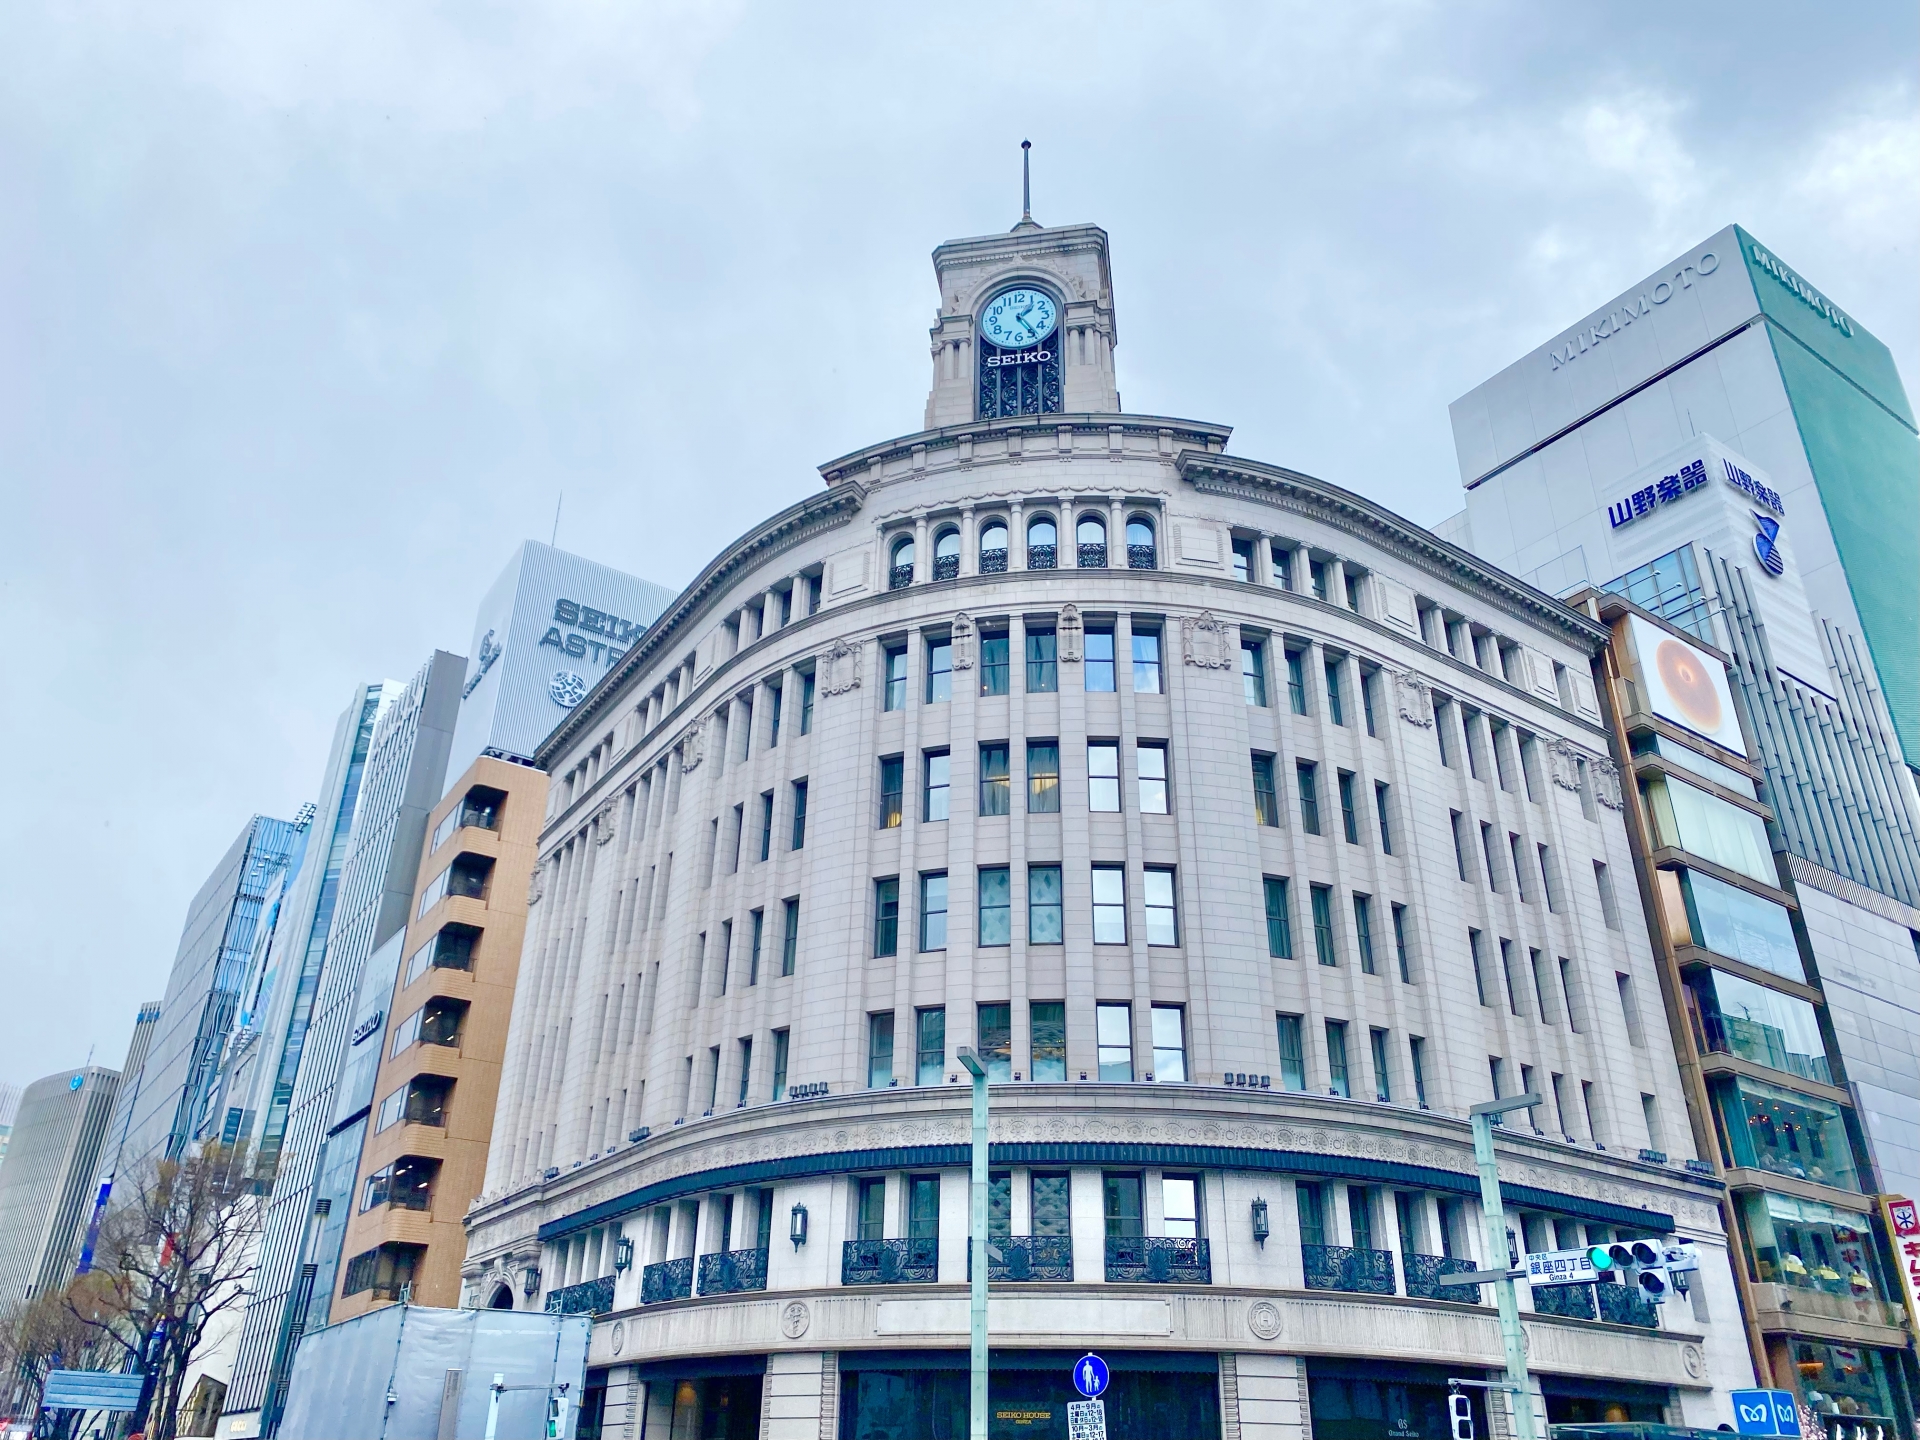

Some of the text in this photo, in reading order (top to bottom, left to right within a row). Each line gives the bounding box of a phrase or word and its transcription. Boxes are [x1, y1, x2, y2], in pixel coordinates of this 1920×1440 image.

[1752, 245, 1855, 338] MIKIMOTO
[1003, 297, 1012, 307] 11
[1014, 293, 1025, 303] 12
[993, 306, 1003, 315] 10
[1037, 301, 1046, 310] 2
[1041, 310, 1050, 320] 3
[1550, 252, 1721, 371] MIKIMOTO
[988, 316, 998, 326] 9
[1036, 321, 1046, 330] 4
[993, 325, 1002, 335] 8
[1027, 328, 1036, 338] 5
[1004, 331, 1013, 341] 7
[1014, 332, 1024, 342] 6
[987, 350, 1051, 367] SEIKO
[1723, 457, 1786, 518] 山野楽器
[1608, 459, 1709, 529] 山野楽器
[1528, 1253, 1547, 1261] 中央区
[1530, 1257, 1591, 1275] 銀座四丁目
[1549, 1273, 1567, 1281] Ginza
[997, 1411, 1021, 1419] SEIKO
